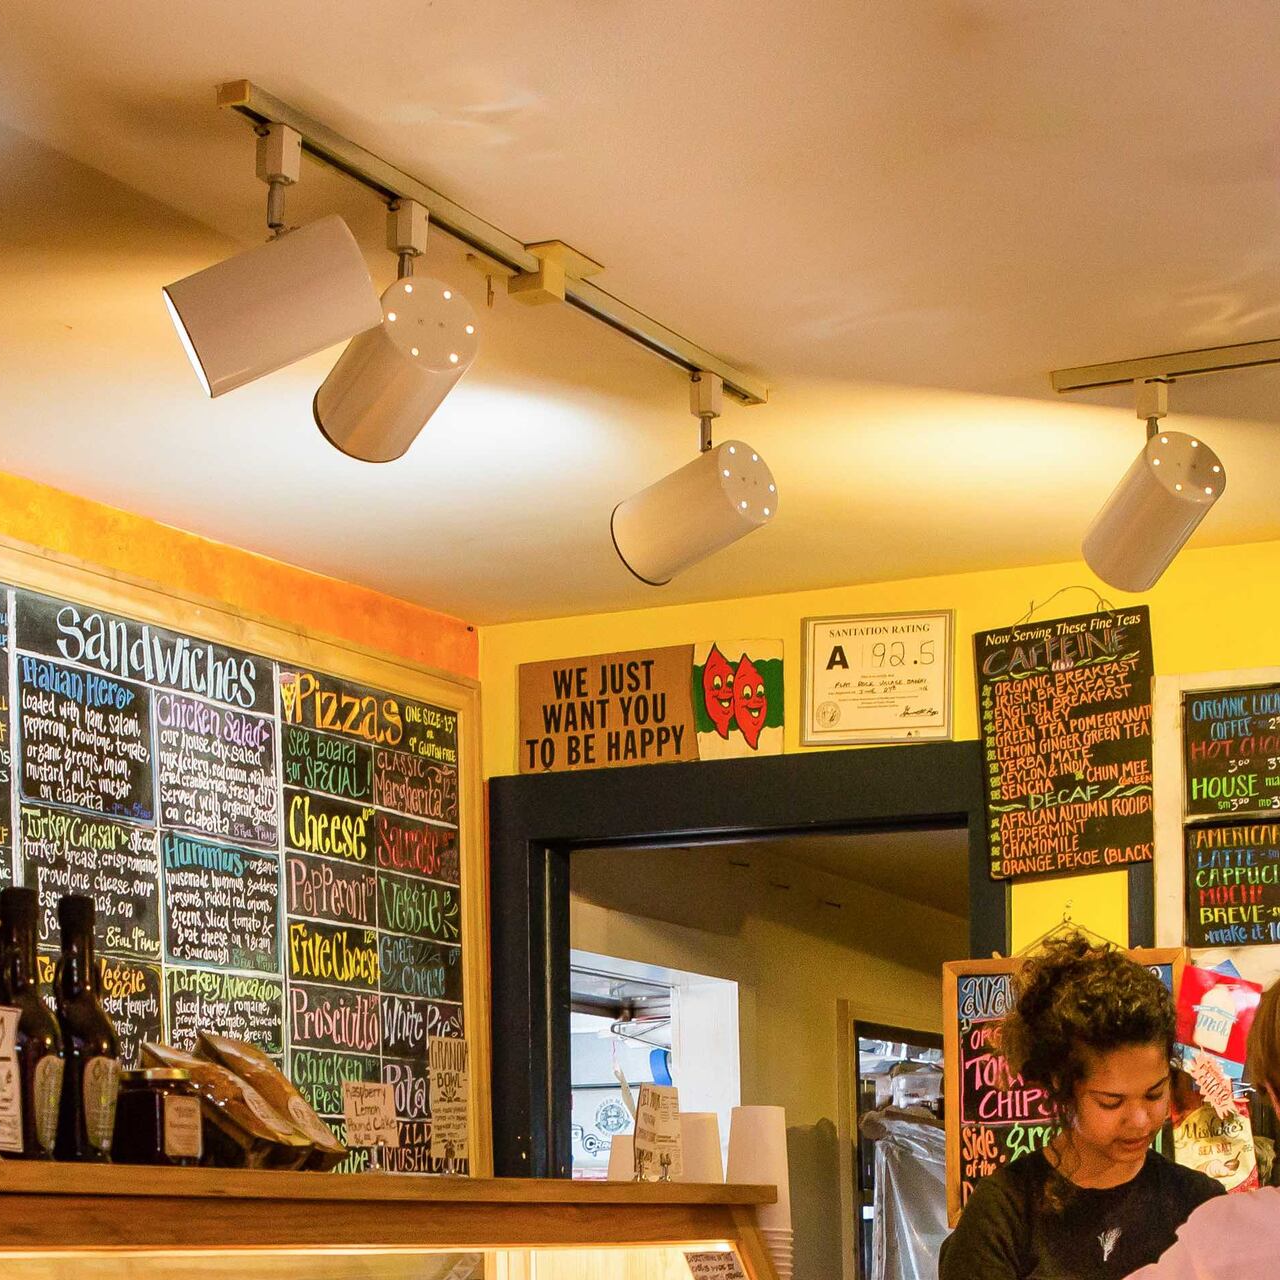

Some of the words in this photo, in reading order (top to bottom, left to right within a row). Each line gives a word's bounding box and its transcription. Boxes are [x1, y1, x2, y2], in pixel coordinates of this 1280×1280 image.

[829, 626, 889, 638] SANITATION
[892, 623, 931, 634] RATING
[985, 633, 1011, 647] Now
[1013, 627, 1053, 642] Serving
[1056, 621, 1087, 637] These
[1090, 617, 1113, 632] Fine
[1116, 613, 1142, 628] Teas
[56, 606, 257, 709] Sandwiches
[826, 645, 850, 671] A
[872, 640, 936, 668] 92.5
[982, 626, 1129, 677] CAFFEINE
[553, 667, 595, 700] WE
[599, 659, 655, 696] JUST
[994, 675, 1050, 697] ORGANIC
[1055, 658, 1140, 686] BREAKFAST
[995, 691, 1031, 708] IRISH
[1037, 672, 1129, 700] BREAKFAST
[156, 694, 221, 738] Chicken
[224, 710, 266, 749] Salad
[295, 672, 404, 746] Pizzas
[542, 699, 612, 735] WANT
[621, 693, 667, 726] YOU
[526, 737, 556, 770] TO
[566, 733, 596, 766] BE
[606, 724, 686, 762] HAPPY
[995, 727, 1036, 747] GREEN
[1038, 722, 1067, 740] TEA
[996, 741, 1036, 761] LEMON
[1039, 732, 1081, 755] GINGER
[1082, 726, 1121, 748] GREEN
[1123, 720, 1152, 740] TEA
[1191, 739, 1235, 761] HOT
[377, 751, 425, 779] CLASSIC
[1086, 763, 1119, 783] CHUN
[1122, 759, 1151, 776] MEE
[1001, 778, 1055, 801] SENCHA
[1028, 784, 1101, 811] DECAF
[1192, 773, 1260, 801] HOUSE
[289, 795, 367, 861] Cheese
[999, 811, 1057, 832] AFRICAN
[1059, 799, 1109, 820] AUTUMN
[1001, 818, 1089, 845] PEPPERMINT
[1002, 834, 1080, 860] CHAMOMILE
[1002, 855, 1056, 876] ORANGE
[1057, 849, 1101, 867] PEKOE
[379, 875, 442, 935] Veggie
[1199, 904, 1266, 926] BREVE
[384, 998, 424, 1049] White
[437, 1072, 462, 1089] BOWL
